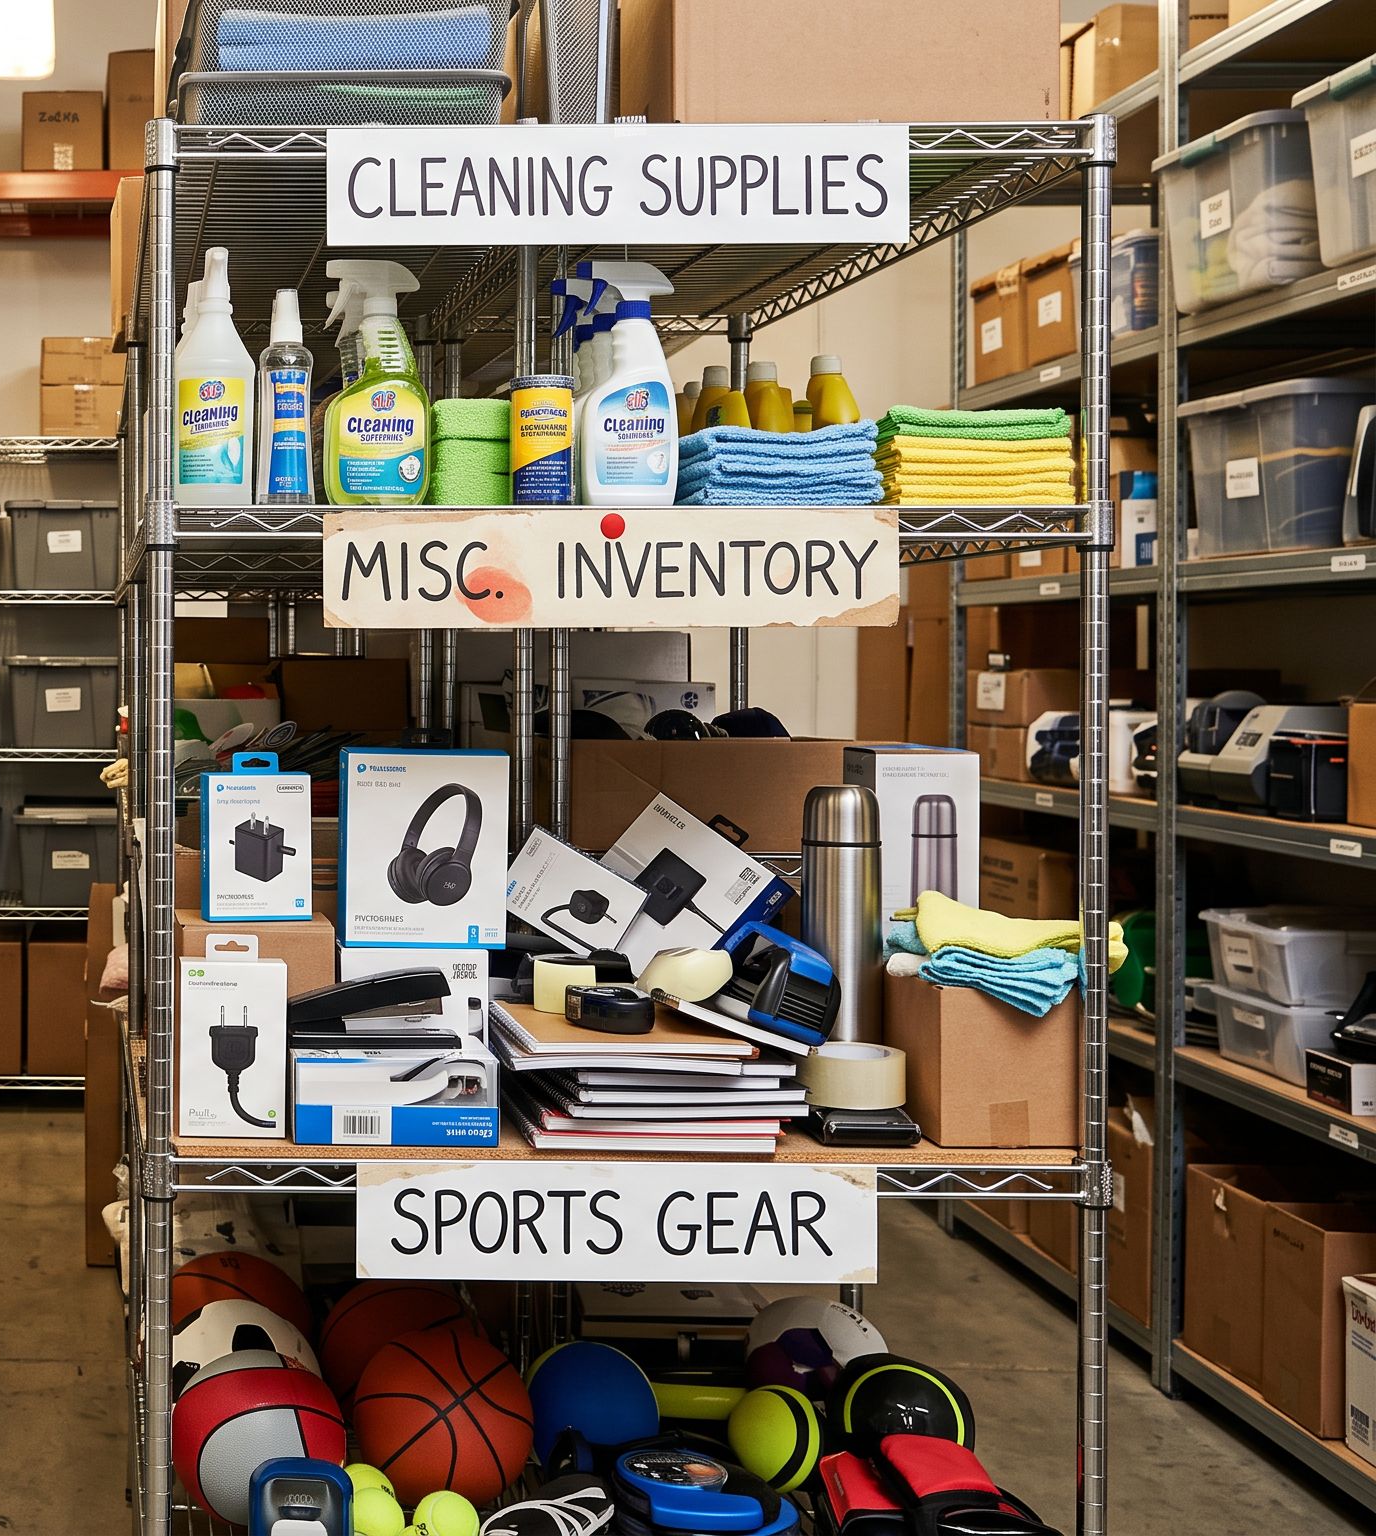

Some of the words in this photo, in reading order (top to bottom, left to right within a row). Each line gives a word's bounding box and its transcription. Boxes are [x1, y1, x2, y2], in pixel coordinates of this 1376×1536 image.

[348, 155, 612, 219] CLEANING
[640, 153, 887, 218] SUPPLIES
[341, 541, 504, 602] MISC.
[558, 540, 879, 600] INVENTORY
[390, 1187, 623, 1256] SPORTS
[656, 1190, 833, 1257] GEAR
